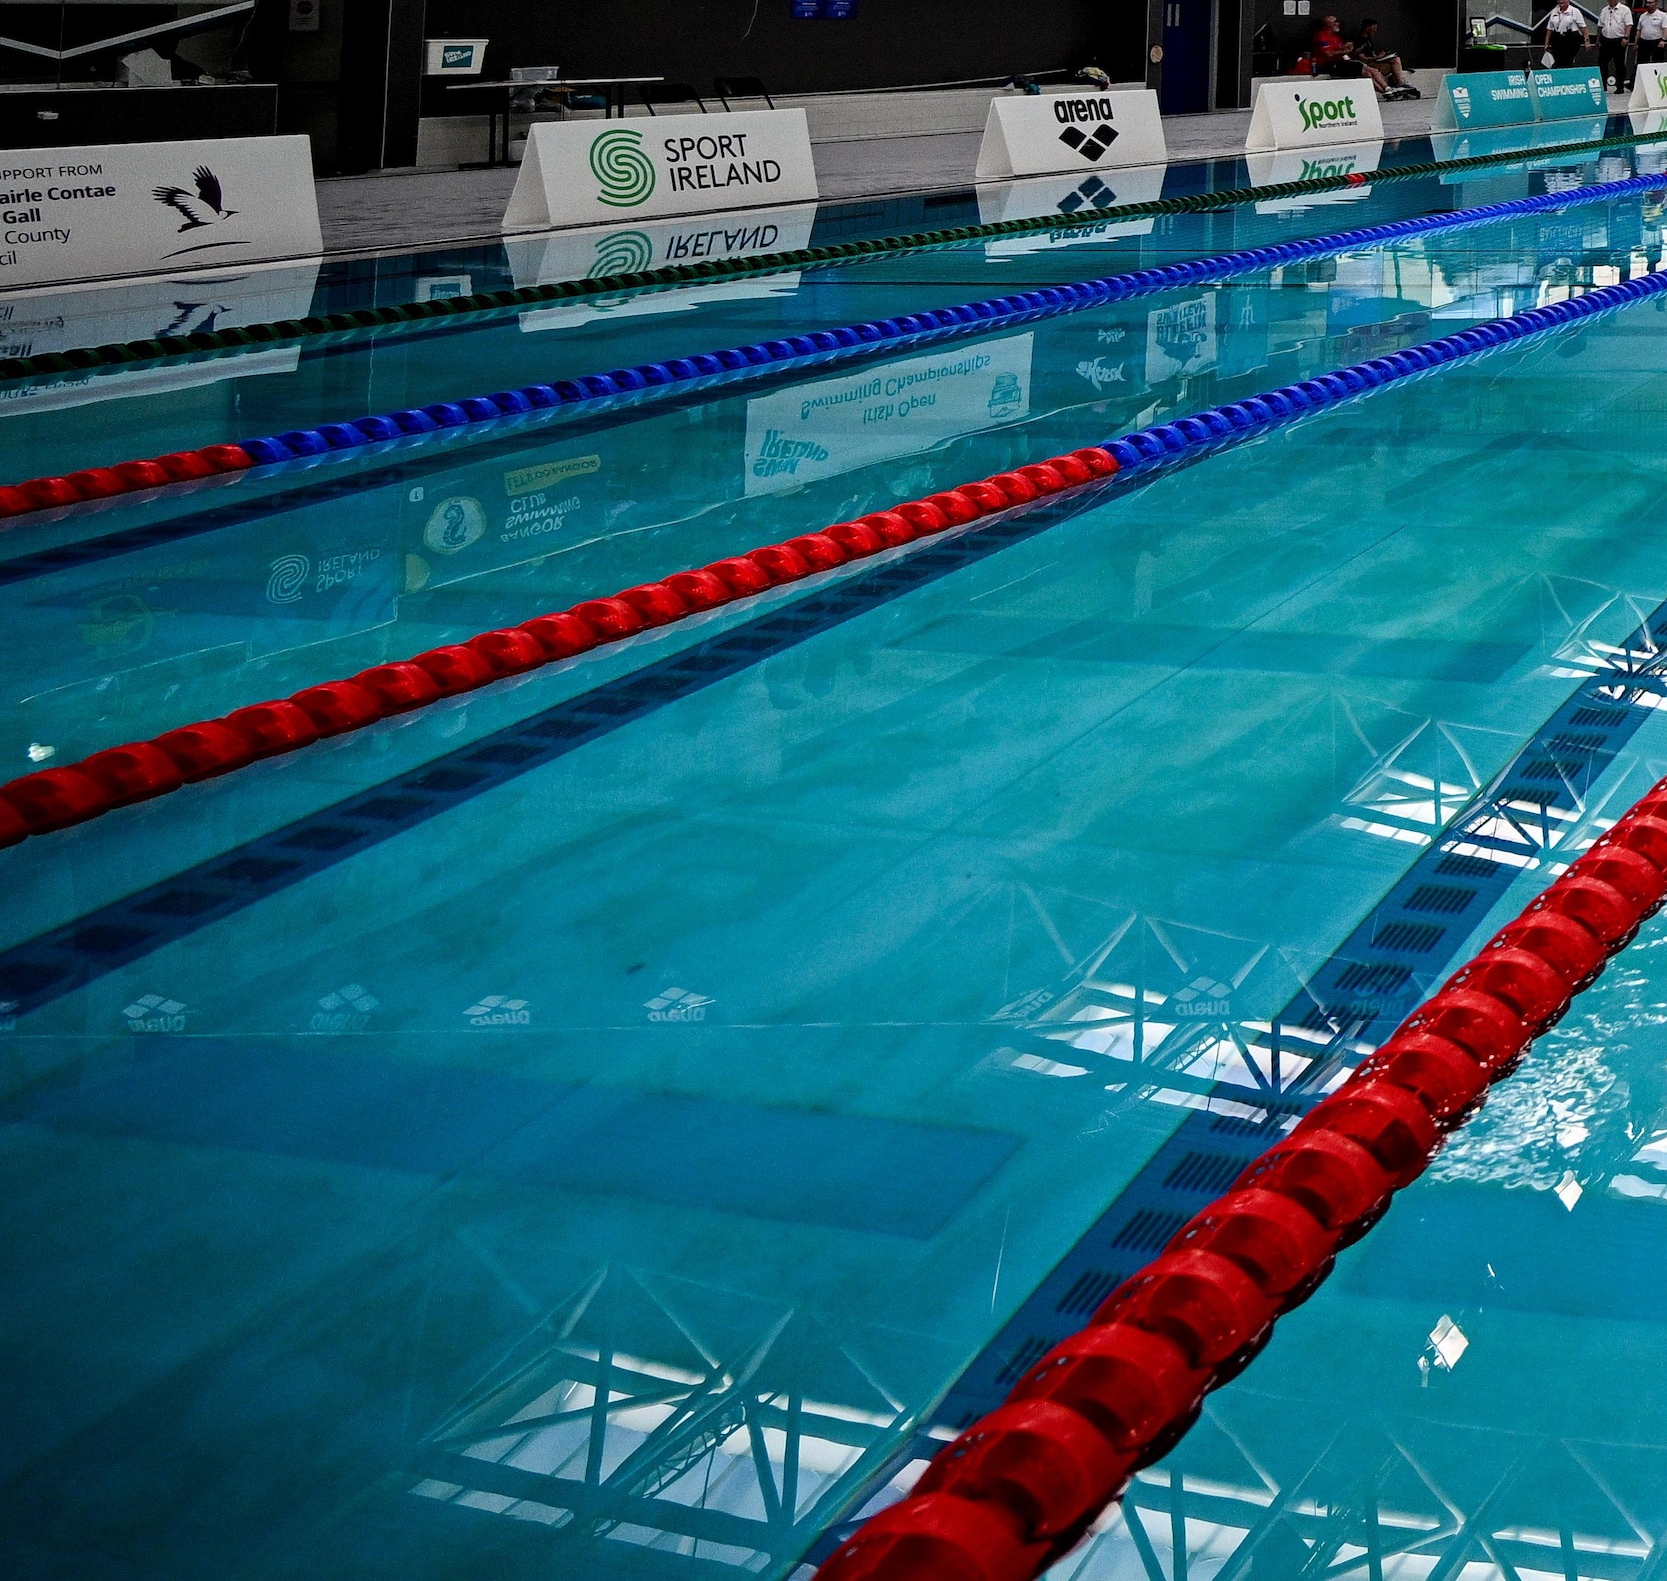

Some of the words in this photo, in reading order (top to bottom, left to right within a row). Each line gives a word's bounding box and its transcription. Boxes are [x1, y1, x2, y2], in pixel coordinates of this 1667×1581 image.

[1508, 75, 1525, 86] IRISH
[1535, 73, 1552, 85] OPEN
[1491, 88, 1529, 101] SWIMMING
[1537, 84, 1587, 98] CHAMPIONSHIPS
[1053, 97, 1114, 124] arena
[1318, 120, 1340, 129] Northern
[1340, 119, 1358, 128] Ireland
[664, 134, 747, 163] SPORT
[0, 167, 54, 181] PPORT
[59, 164, 103, 177] FROM
[669, 159, 781, 192] IRELAND
[47, 185, 116, 201] Contae
[2, 207, 41, 224] Gall
[4, 228, 71, 245] County
